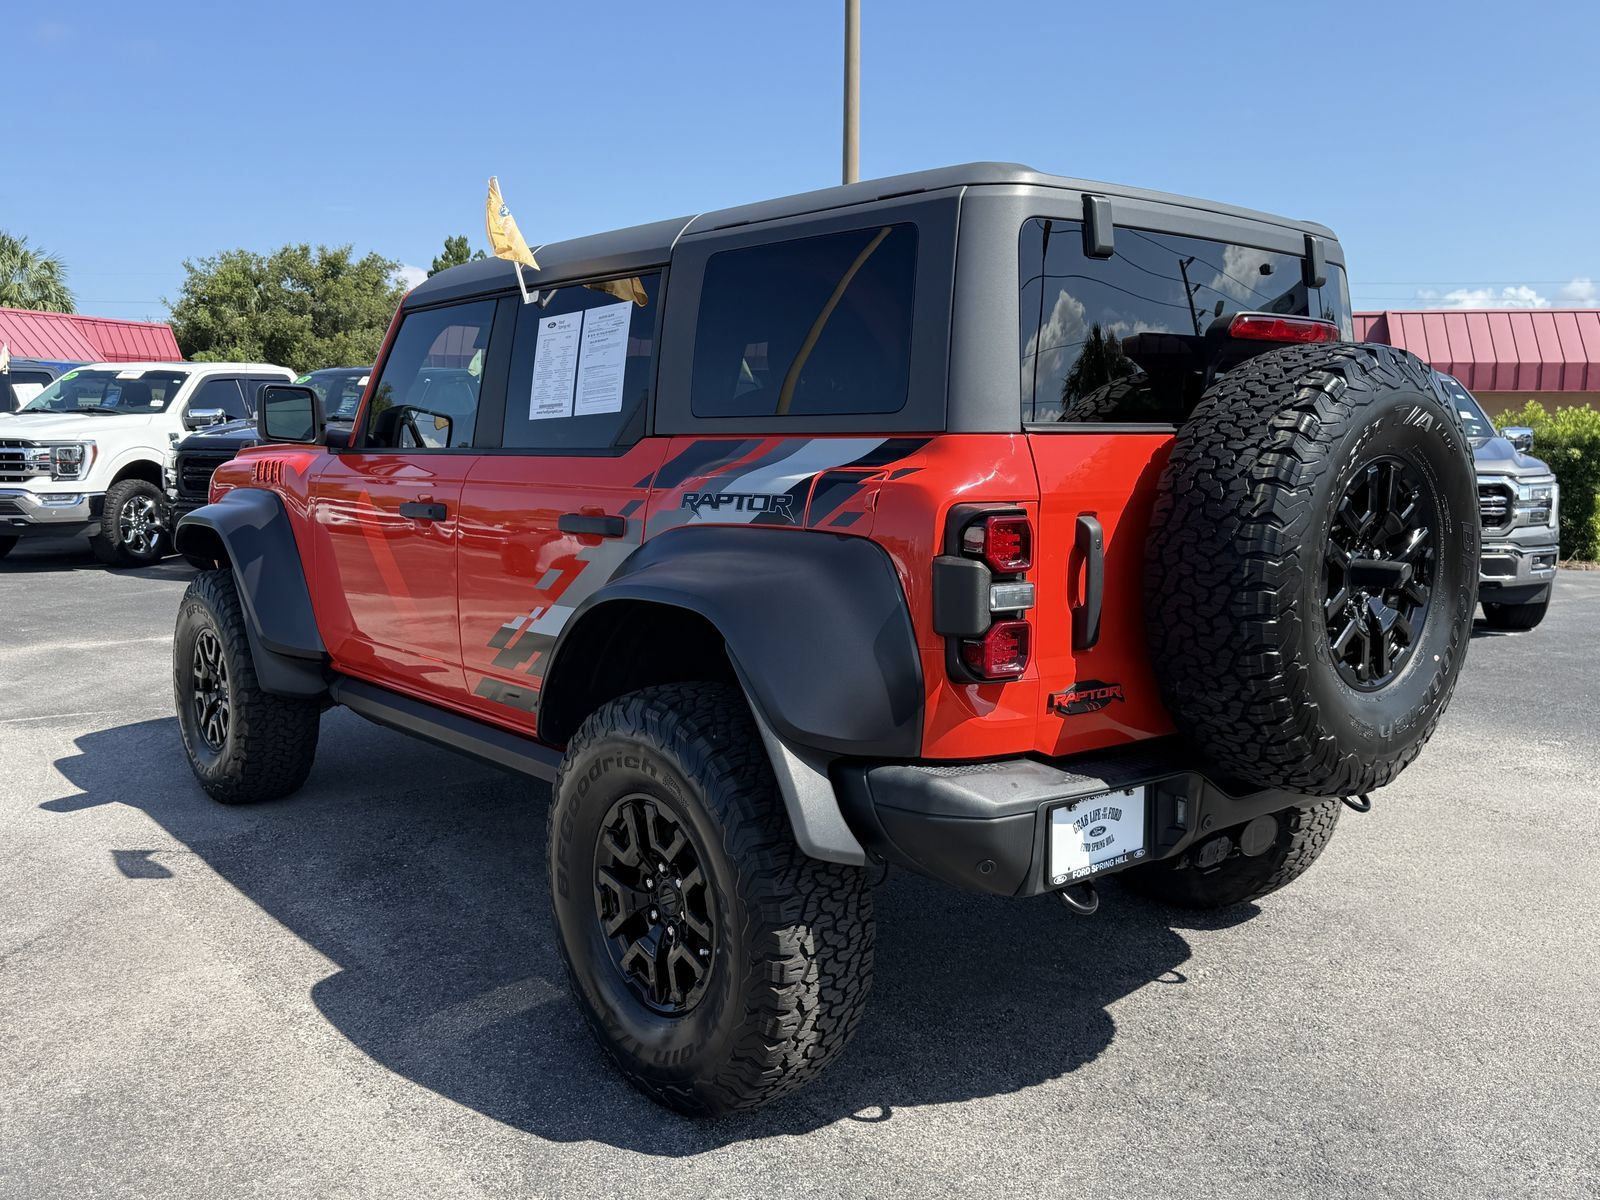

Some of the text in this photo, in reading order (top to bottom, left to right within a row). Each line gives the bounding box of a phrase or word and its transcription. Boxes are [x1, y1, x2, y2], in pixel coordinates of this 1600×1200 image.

[681, 491, 796, 523] RAPTOR
[1054, 685, 1123, 708] RAPTOR
[557, 751, 658, 898] BFGoodrich
[1072, 813, 1089, 834] GRAB
[1089, 807, 1102, 823] LIFE
[1107, 806, 1123, 821] FORD
[1091, 838, 1106, 852] SPRING
[1105, 833, 1115, 847] HILL
[1072, 854, 1129, 879] FORD SPRING HILL
